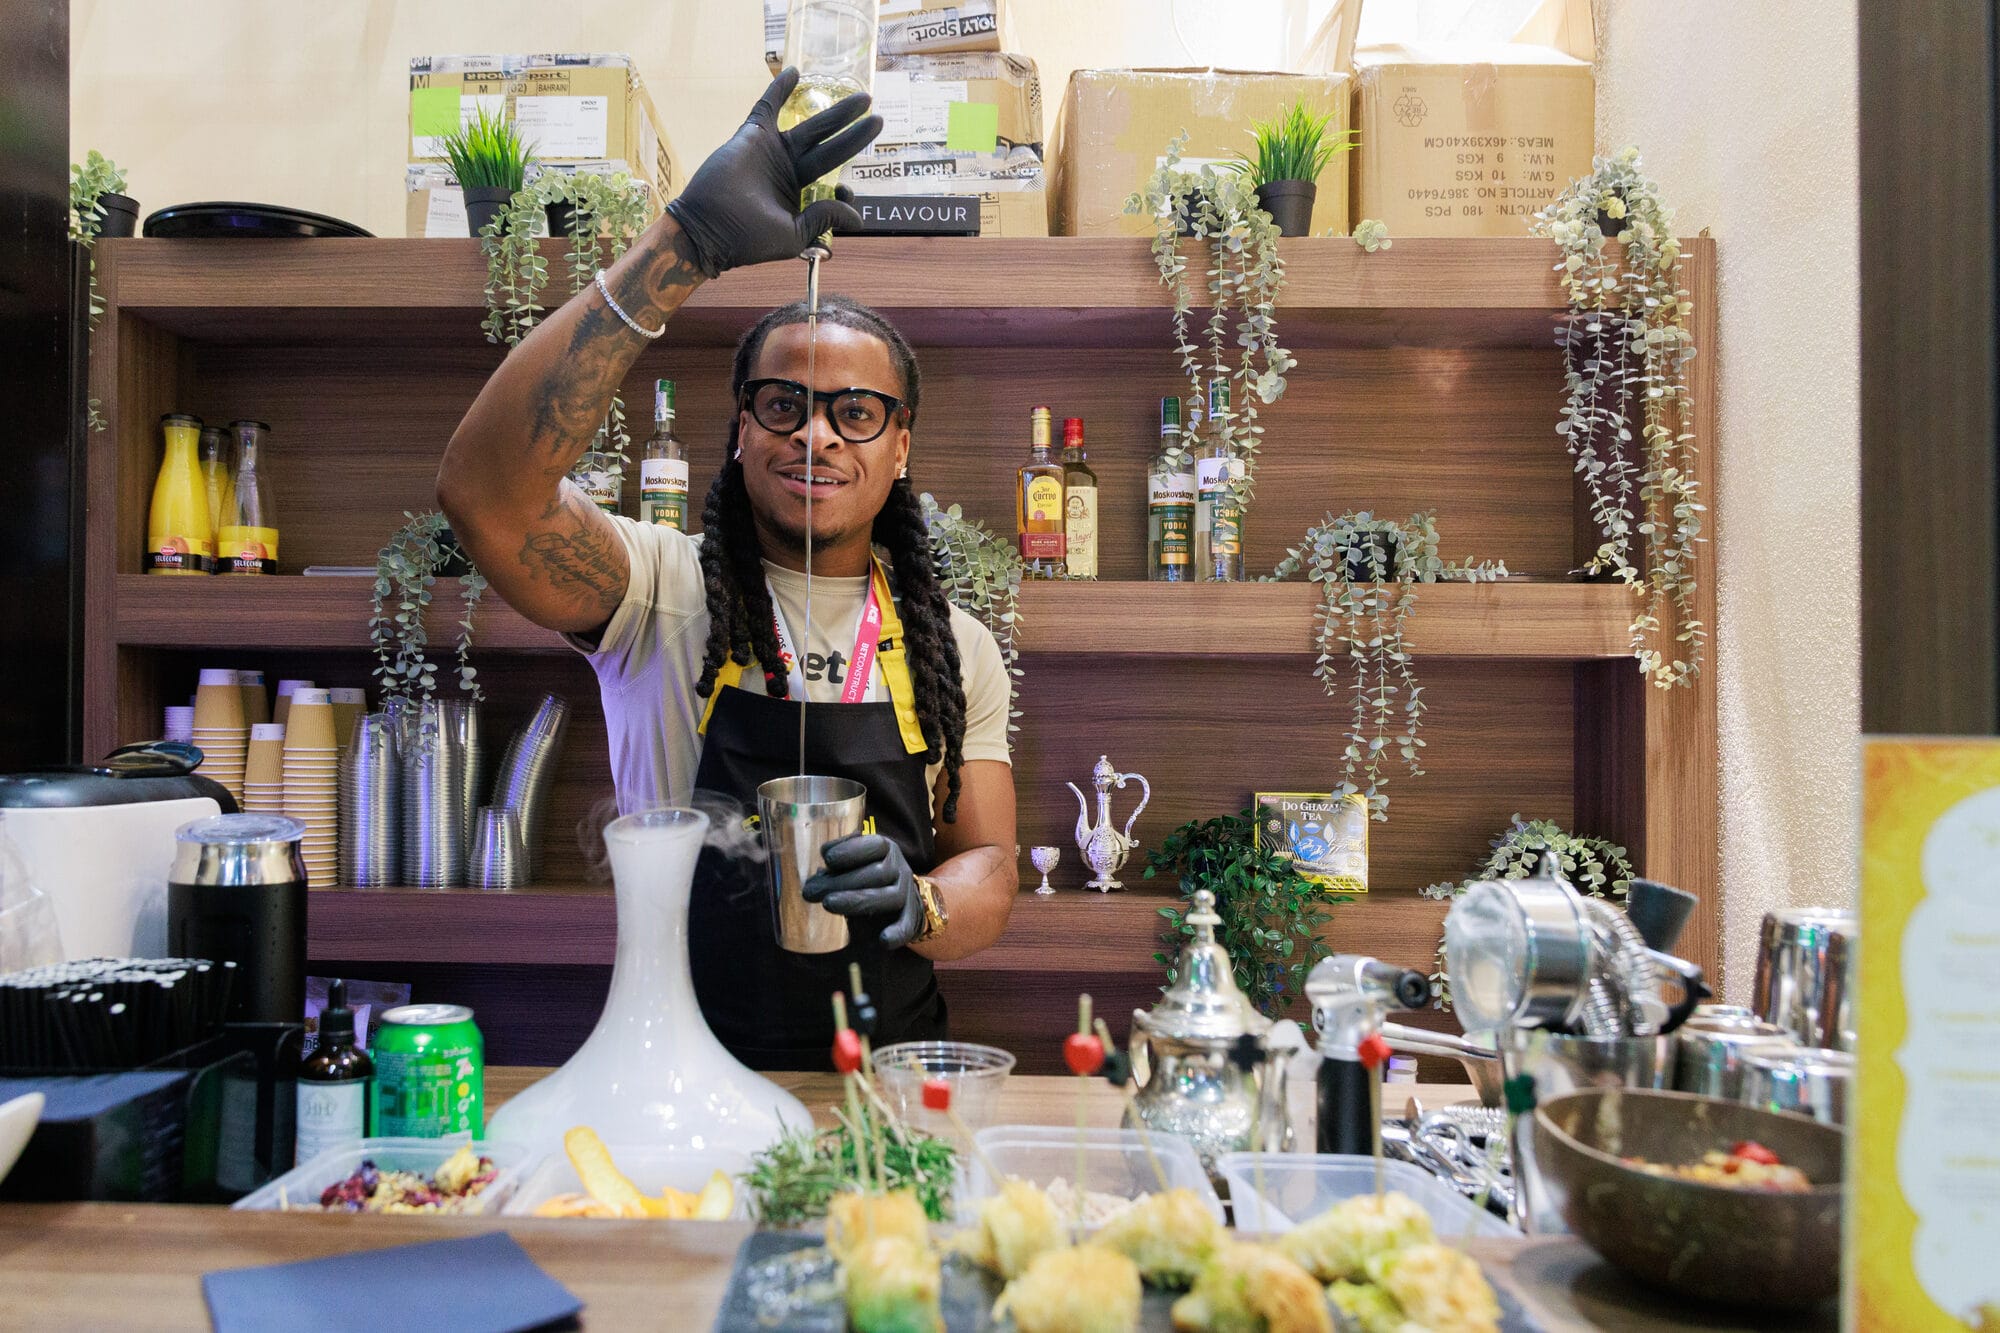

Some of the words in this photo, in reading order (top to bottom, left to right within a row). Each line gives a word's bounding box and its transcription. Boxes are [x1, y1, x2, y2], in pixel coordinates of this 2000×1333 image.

[911, 20, 957, 41] Sport.
[479, 85, 488, 94] M
[1456, 153, 1484, 164] KGS
[1496, 152, 1504, 163] 9
[855, 163, 901, 179] Sport.
[1455, 170, 1483, 181] KGS
[1491, 169, 1506, 180] 10
[1408, 188, 1469, 200] 38676440
[1475, 187, 1496, 198] NO.
[1501, 187, 1555, 199] ARTICLE
[862, 205, 967, 221] FLAVOUR
[1425, 205, 1451, 217] PCS
[1462, 204, 1483, 216] 180
[655, 509, 679, 518] VODKA
[1163, 521, 1188, 531] VODKA
[847, 642, 870, 702] BETCONSTRUCT
[1301, 812, 1322, 821] TEA
